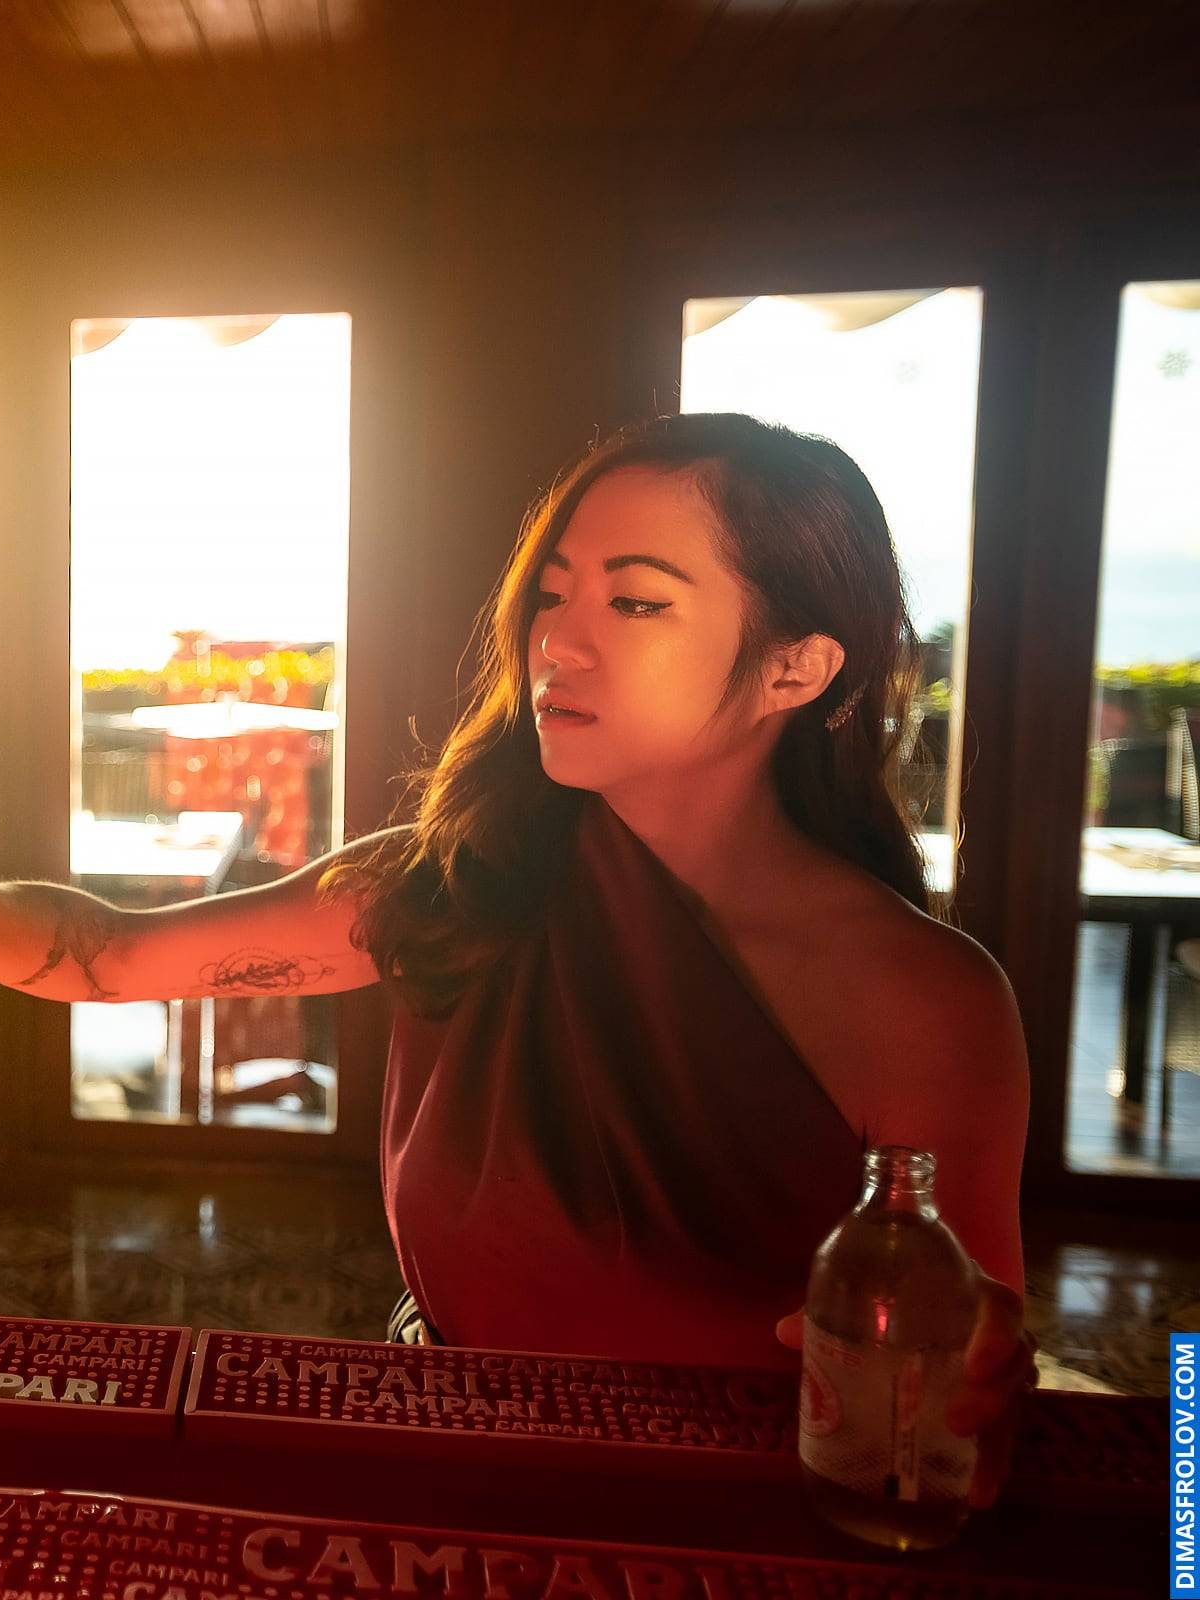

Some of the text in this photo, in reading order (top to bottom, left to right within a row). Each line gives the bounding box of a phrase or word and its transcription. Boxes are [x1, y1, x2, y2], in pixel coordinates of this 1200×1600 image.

[33, 1353, 146, 1370] CAMPARI
[300, 1345, 395, 1361] CAMPARI
[216, 1352, 480, 1395] CAMPARI
[345, 1389, 542, 1418] CAMPARI
[495, 1420, 601, 1438] CAMPARI
[61, 1530, 208, 1560] CAMPARI
[109, 1560, 230, 1587] CAMPARI
[243, 1526, 728, 1600] CAMPARI
